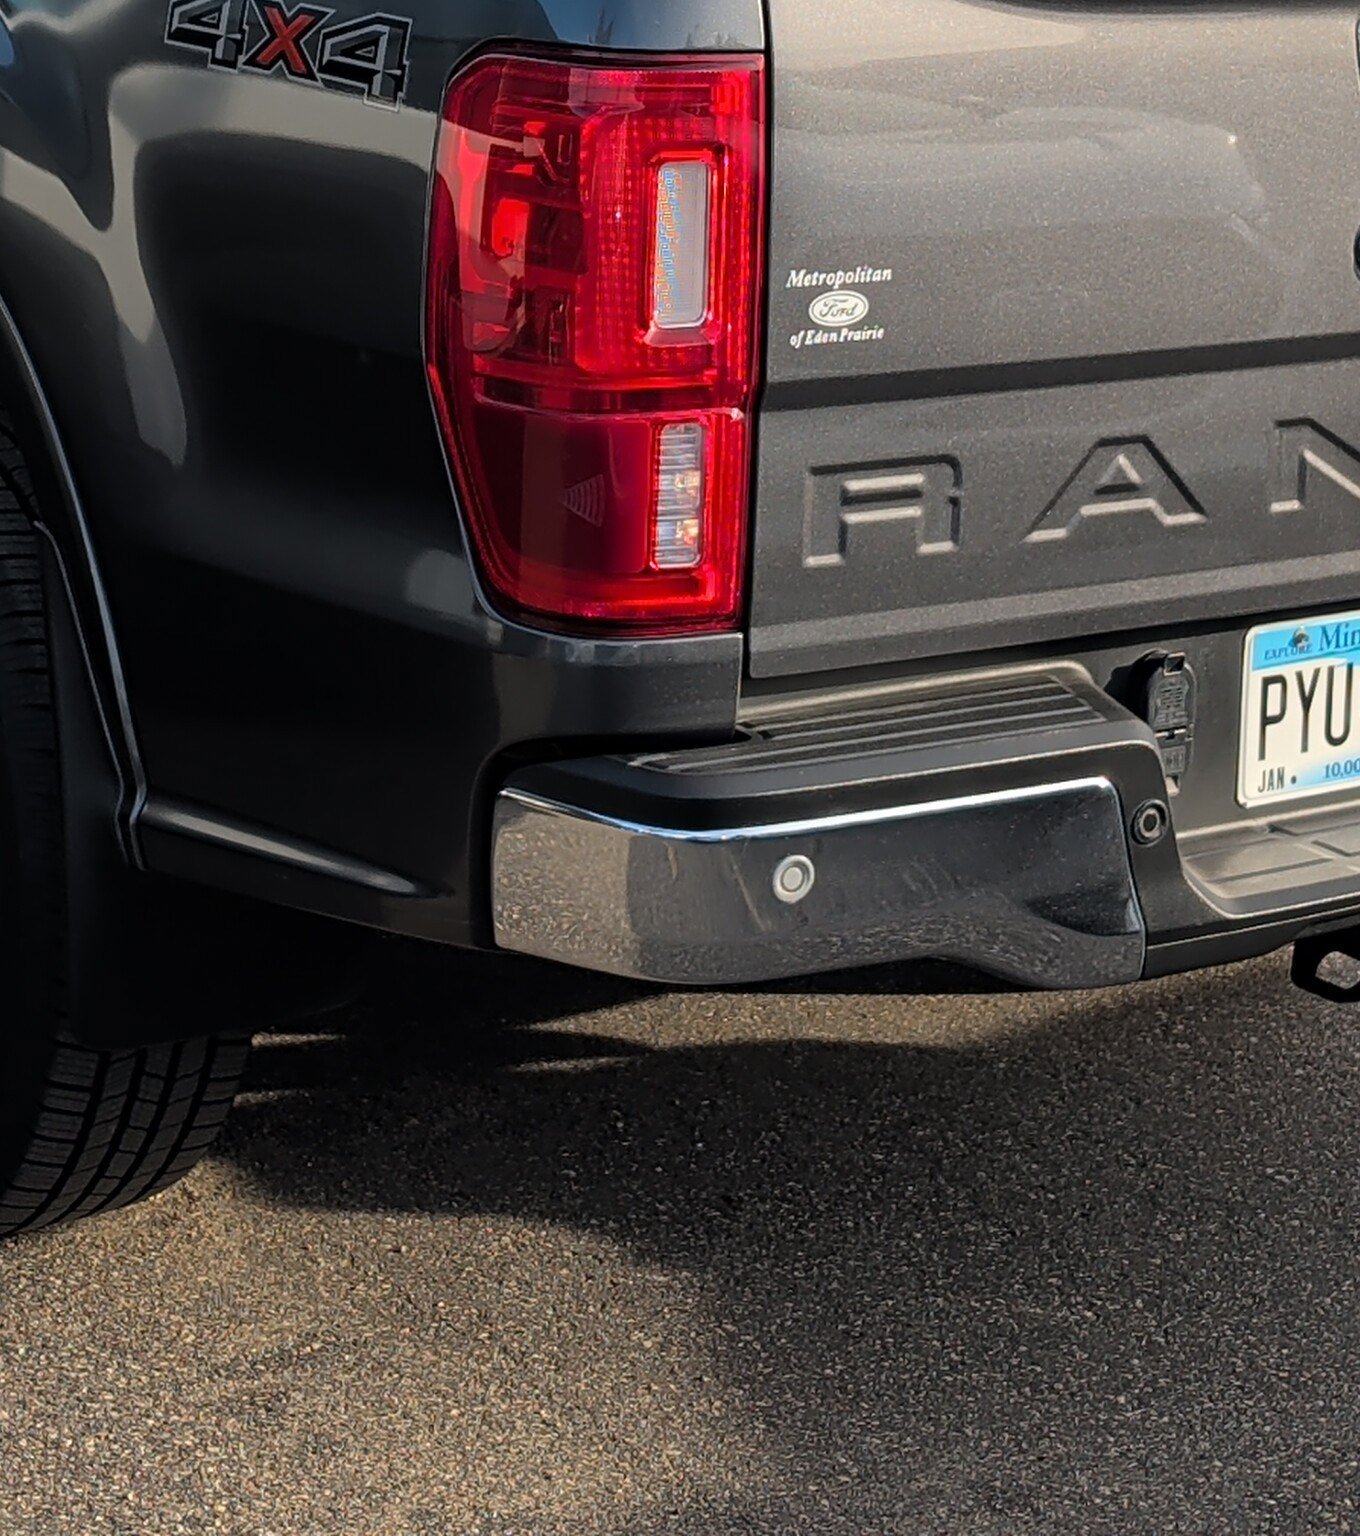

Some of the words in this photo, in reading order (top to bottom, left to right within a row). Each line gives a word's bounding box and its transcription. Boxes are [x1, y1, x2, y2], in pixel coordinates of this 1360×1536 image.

[785, 266, 892, 289] Metropolitan
[819, 299, 858, 318] Ford
[790, 330, 805, 349] of
[805, 329, 837, 346] Eden
[839, 325, 884, 343] Prairie
[1257, 663, 1354, 761] PYU
[1258, 767, 1285, 793] JAN
